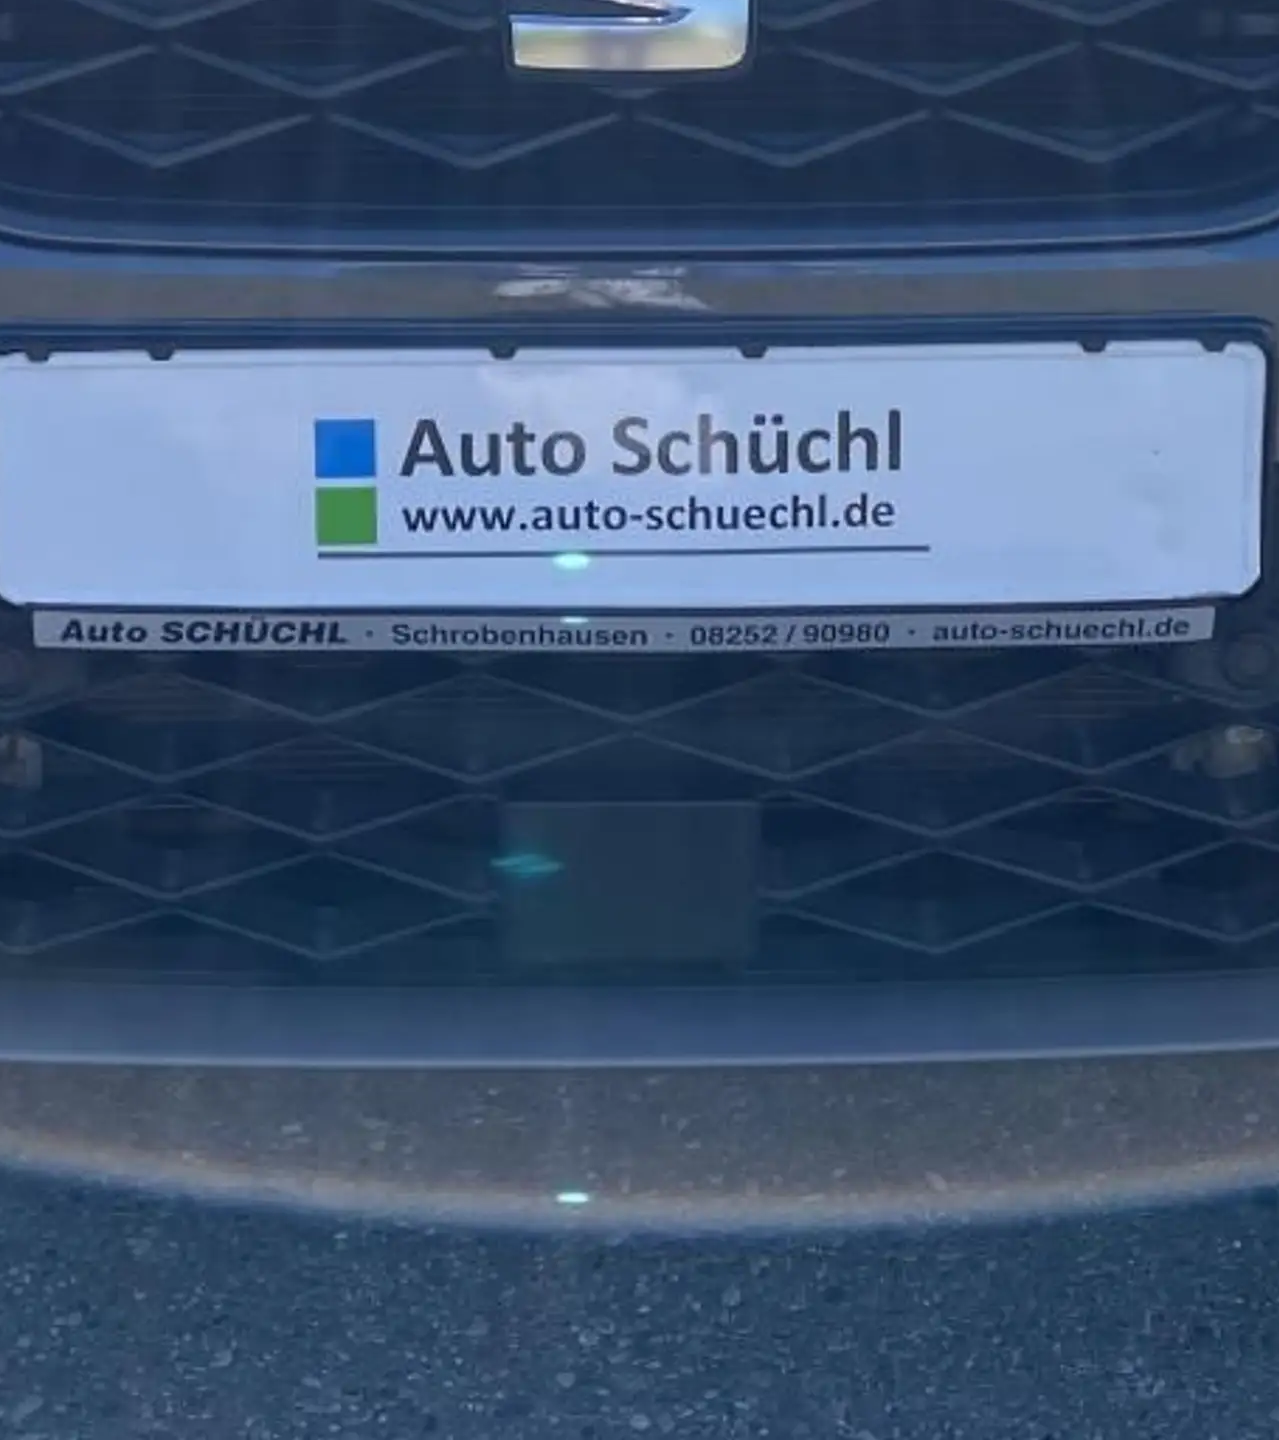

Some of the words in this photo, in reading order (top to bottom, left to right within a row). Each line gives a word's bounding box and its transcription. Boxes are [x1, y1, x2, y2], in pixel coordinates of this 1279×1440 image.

[399, 417, 587, 478] Auto
[611, 408, 902, 477] Schüchl
[402, 492, 897, 533] www.auto-schuechl.de
[59, 617, 148, 644] Auto
[159, 615, 348, 645] SCHÜCHL
[391, 621, 648, 647] Schrobenhausen
[690, 624, 779, 646] 08252
[803, 621, 891, 644] 90980
[932, 616, 1191, 642] auto-schuechl.de
